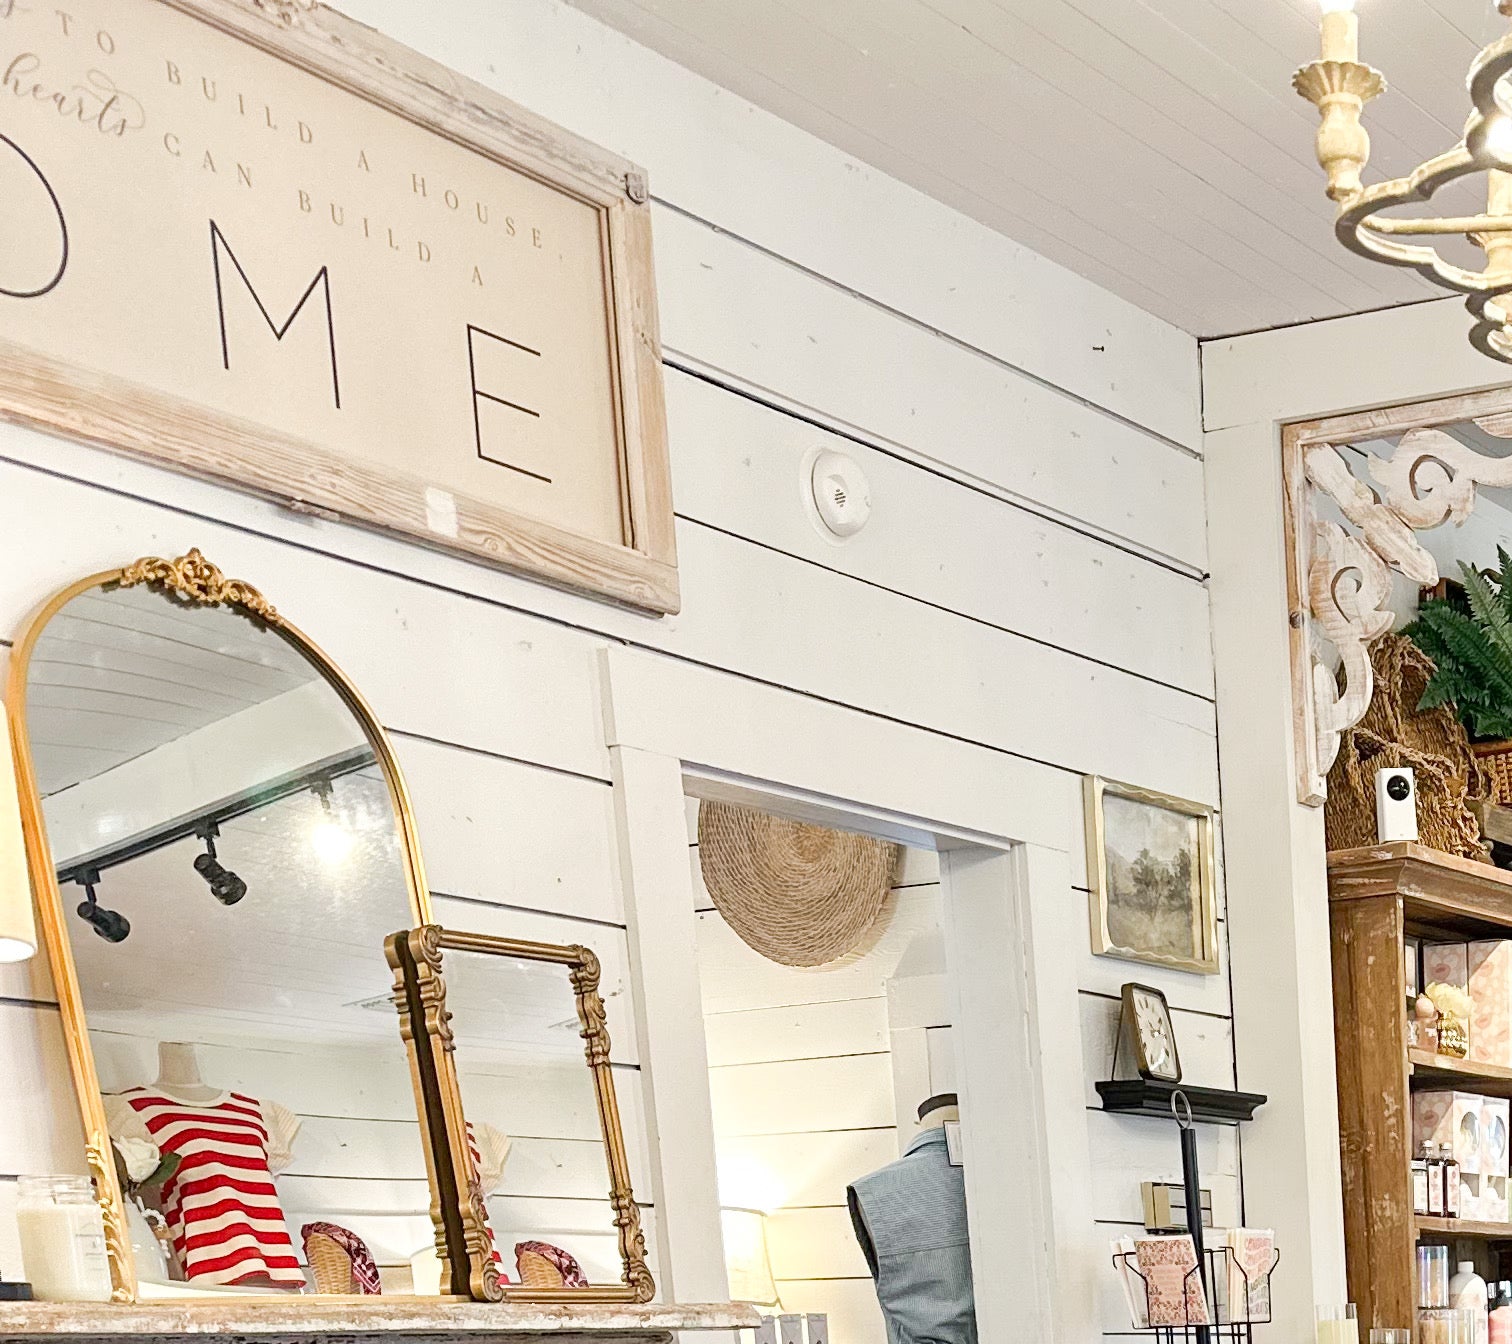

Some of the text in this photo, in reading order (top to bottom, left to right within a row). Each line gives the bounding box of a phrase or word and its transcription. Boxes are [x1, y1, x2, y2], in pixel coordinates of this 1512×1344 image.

[3, 52, 484, 286] hearts CAN BUILD A
[55, 9, 115, 54] TO
[166, 60, 313, 144] BUILD
[357, 150, 370, 172] A
[0, 134, 552, 484] OME
